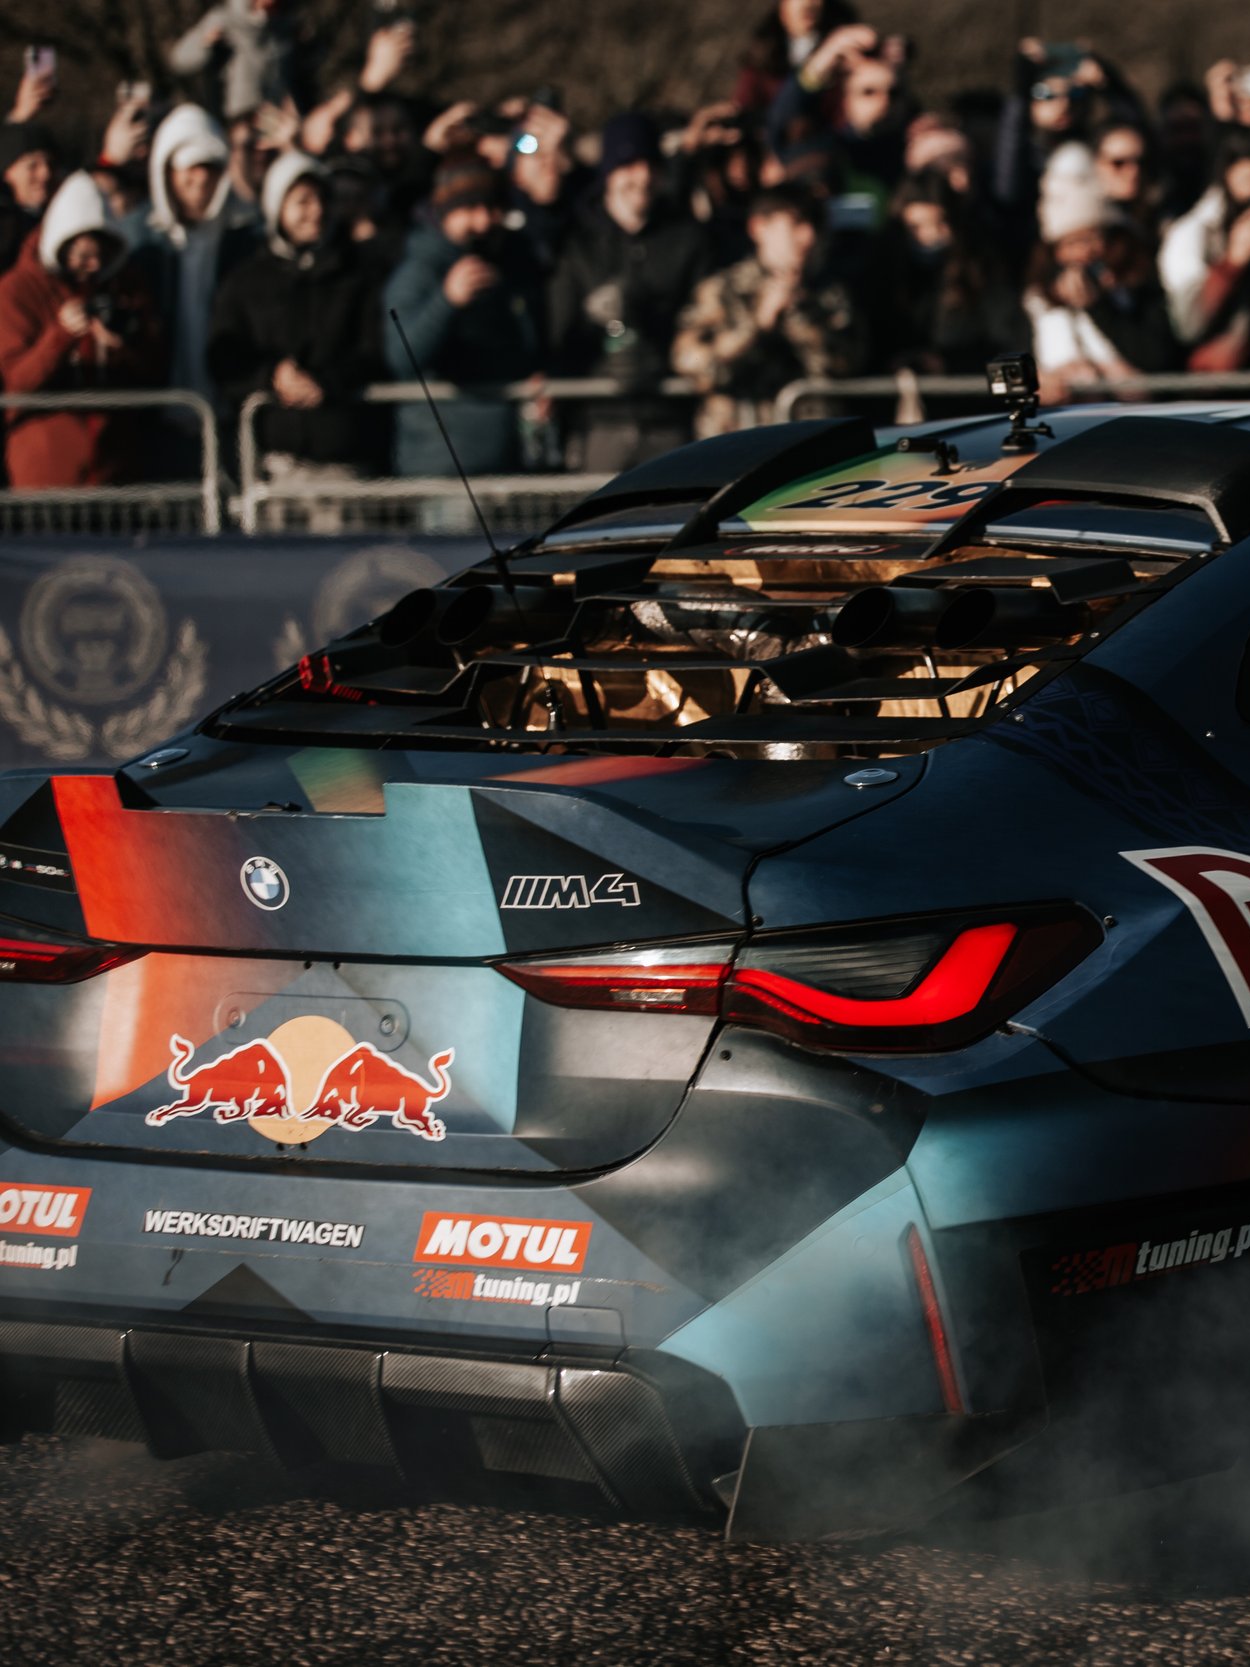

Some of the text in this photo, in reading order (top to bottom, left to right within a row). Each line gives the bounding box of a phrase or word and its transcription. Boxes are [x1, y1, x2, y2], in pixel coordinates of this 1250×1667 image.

[767, 480, 1004, 511] 229
[0, 1188, 80, 1229] OTUL
[144, 1209, 365, 1249] WERKSDRIFTWAGEN
[422, 1218, 580, 1266] MOTUL
[0, 1240, 79, 1271] tuning.pl
